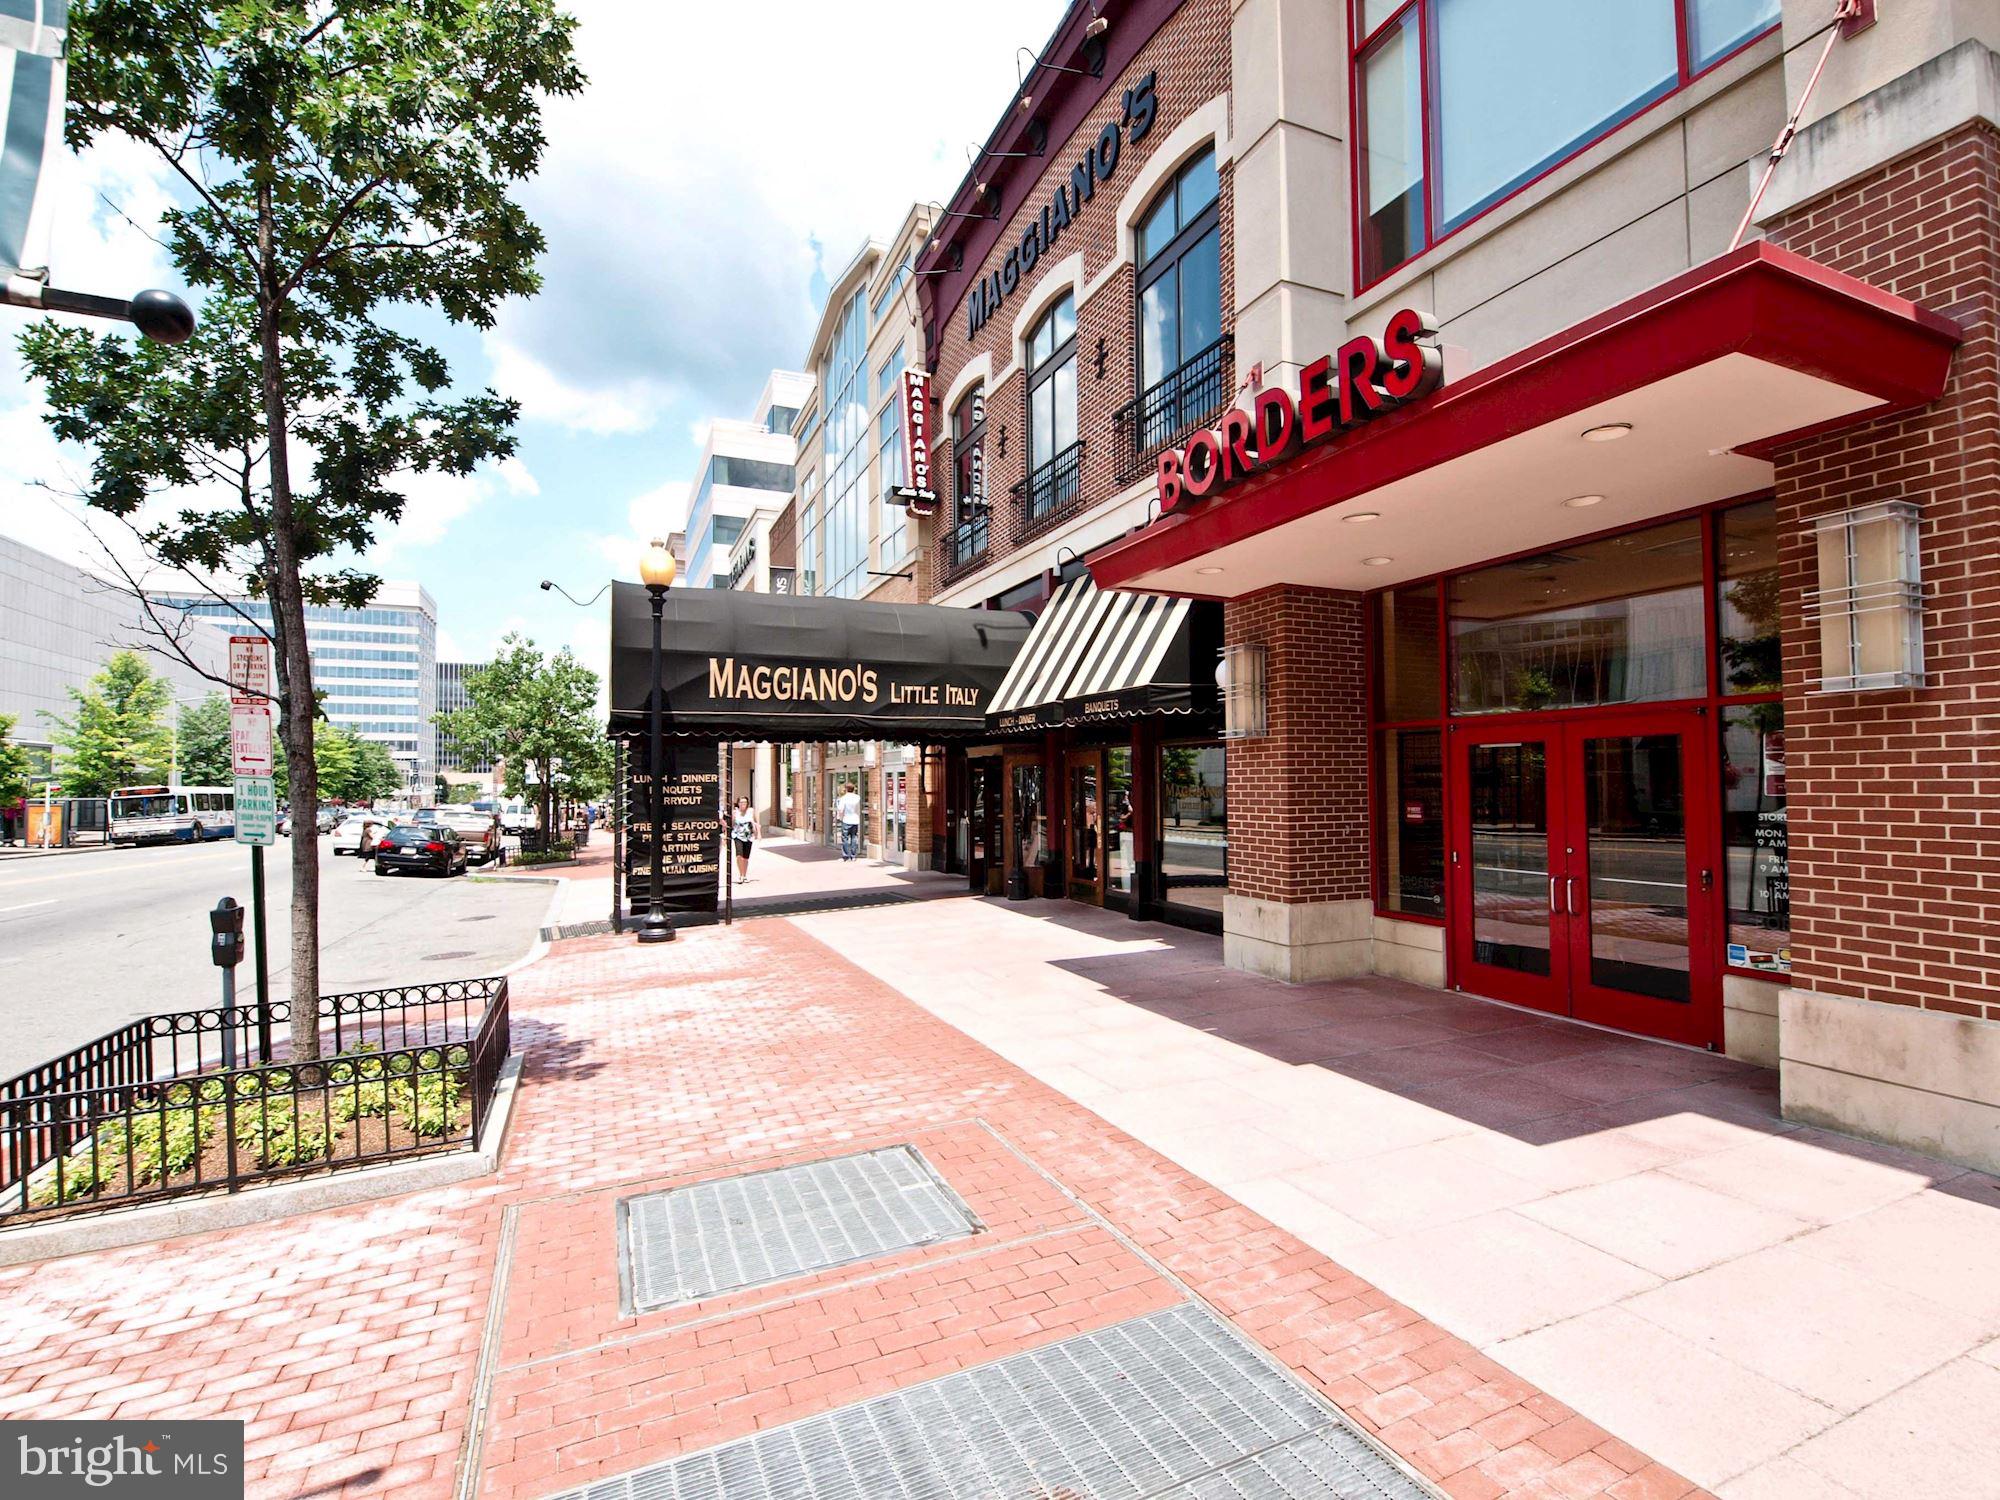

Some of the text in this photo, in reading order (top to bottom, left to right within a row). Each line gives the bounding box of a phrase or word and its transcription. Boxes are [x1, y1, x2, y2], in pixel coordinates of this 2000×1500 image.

[967, 71, 1157, 341] MAGGIANO'S
[1157, 309, 1428, 513] BORDERS
[909, 374, 930, 489] MAGGIANO'S
[708, 657, 980, 706] MAGGIANO'S LITTLE ITALY
[1084, 699, 1119, 714] BANQUETS
[1018, 714, 1037, 724] DINNER
[681, 774, 718, 783] DINNER
[247, 785, 268, 797] HOUR
[237, 799, 272, 811] PARKING
[671, 821, 719, 831] SEAFOOD
[677, 832, 710, 841] STEAK
[1755, 829, 1785, 838] MON.
[1757, 838, 1787, 848] 9 AM
[676, 854, 703, 863] WINE
[687, 864, 719, 874] CUISINE
[1760, 864, 1767, 872] 9
[1760, 890, 1770, 898] 10
